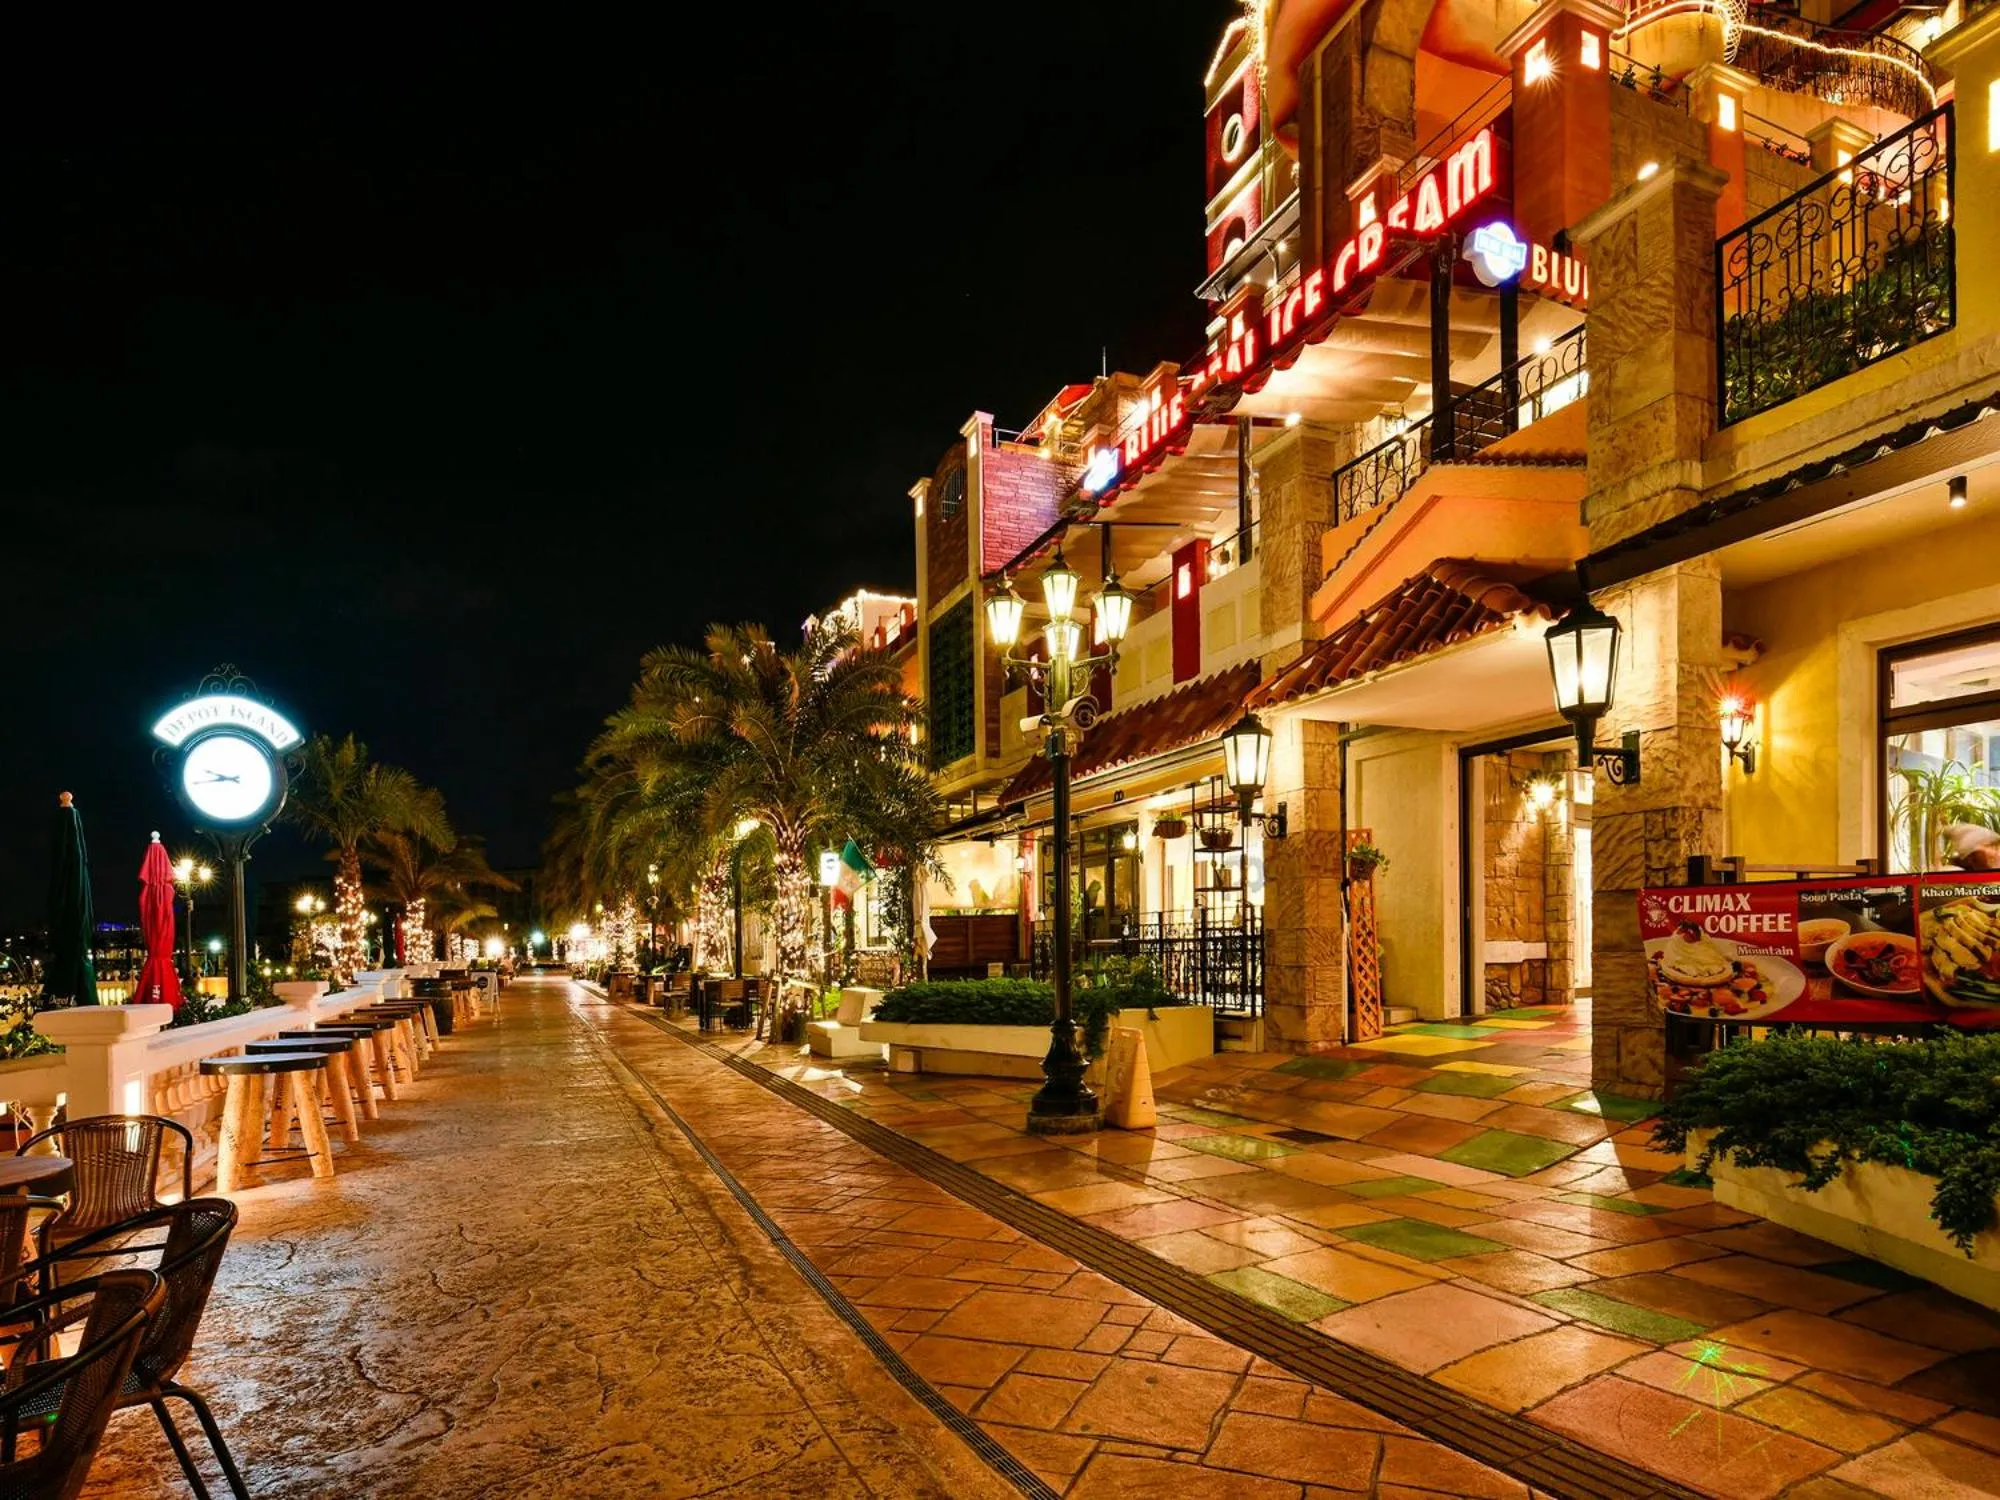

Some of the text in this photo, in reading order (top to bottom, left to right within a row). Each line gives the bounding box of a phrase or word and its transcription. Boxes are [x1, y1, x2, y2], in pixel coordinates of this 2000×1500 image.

[1532, 243, 1589, 300] BLU
[1270, 269, 1324, 345] ICE
[164, 704, 290, 744] DEPOT ISLAND
[1801, 889, 1863, 903] Soup Pasta
[1921, 887, 1953, 898] Khao
[1954, 886, 1981, 896] Man
[1668, 893, 1752, 913] CLIMAX
[1704, 913, 1793, 934] COFFEE
[1737, 944, 1794, 957] Mountain
